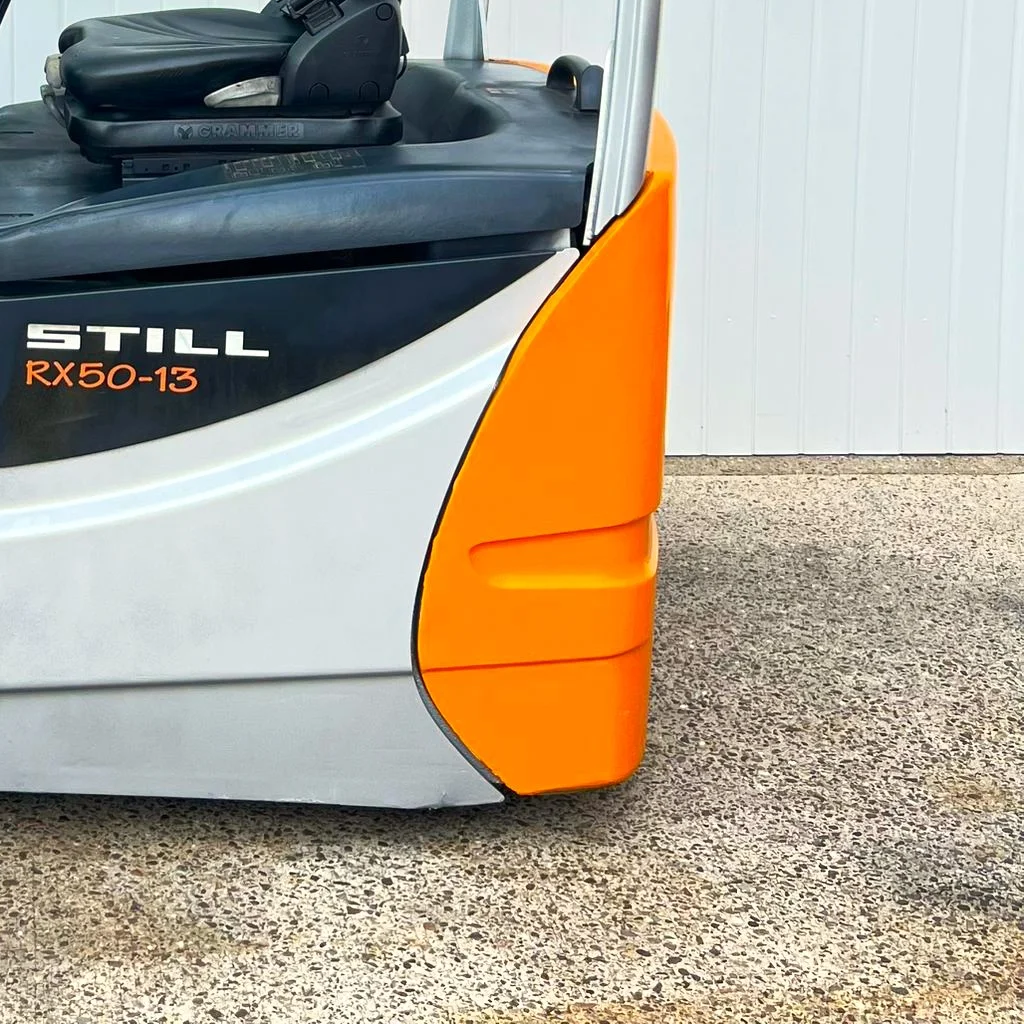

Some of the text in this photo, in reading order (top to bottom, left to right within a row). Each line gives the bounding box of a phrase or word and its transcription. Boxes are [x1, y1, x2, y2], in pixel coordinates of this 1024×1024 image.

[198, 123, 301, 138] GRAMMER
[26, 323, 270, 357] STILL
[26, 359, 198, 393] RX50-13
